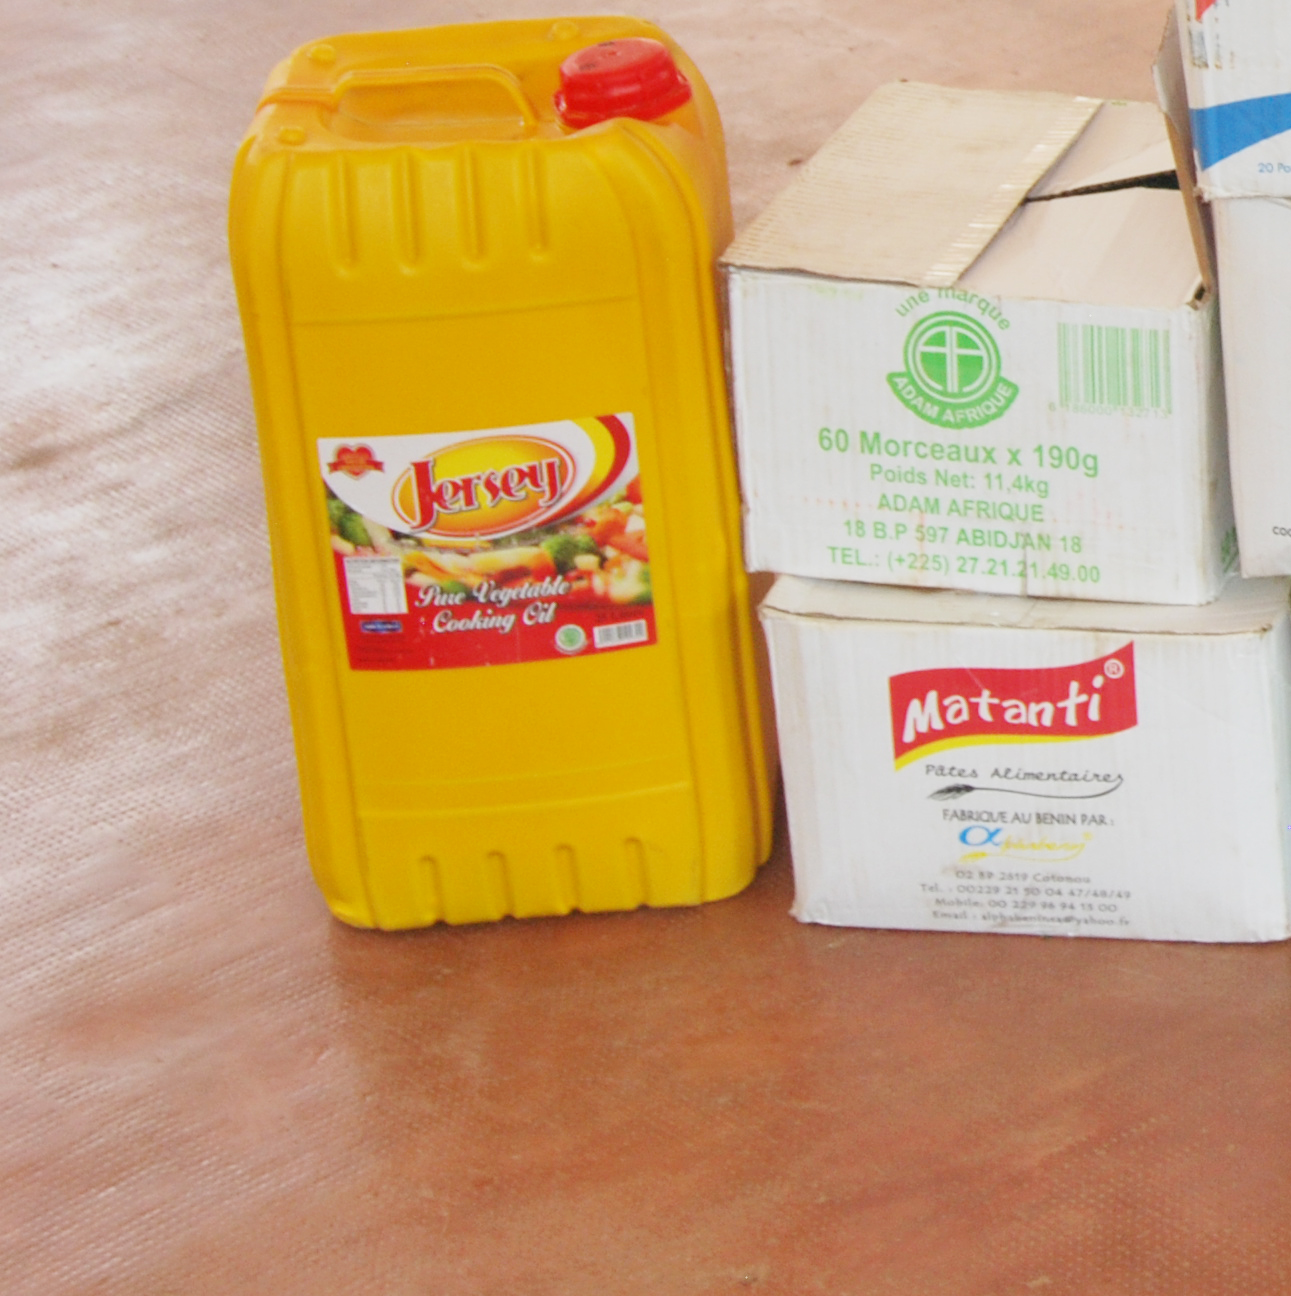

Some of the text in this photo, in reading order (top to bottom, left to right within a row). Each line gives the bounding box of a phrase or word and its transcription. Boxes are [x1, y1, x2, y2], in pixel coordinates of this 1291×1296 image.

[1257, 162, 1275, 174] 20
[895, 290, 930, 317] une
[938, 287, 1010, 330] marque
[893, 377, 1012, 423] ADAM AFRIQUE
[818, 428, 1099, 478] 60 Morceaux x 190g
[870, 464, 929, 486] Poids
[935, 468, 975, 489] Net:
[407, 457, 561, 533] Jersey
[877, 493, 1044, 524] ADAM AFRIQUE
[844, 521, 866, 538] 18
[914, 525, 949, 544] 597
[956, 529, 1052, 551] ABIDJAN
[1060, 535, 1082, 554] 18
[887, 552, 950, 575] (+225)
[957, 556, 1100, 584] 27.21.21.49.00
[415, 585, 466, 608] Pure
[472, 575, 571, 607] Vegetable
[433, 602, 557, 634] Cooking Oil
[902, 675, 1106, 744] Matanti
[925, 763, 1125, 784] Pâtes Alimentaires
[1011, 811, 1033, 825] AU
[1035, 811, 1077, 826] BENIN
